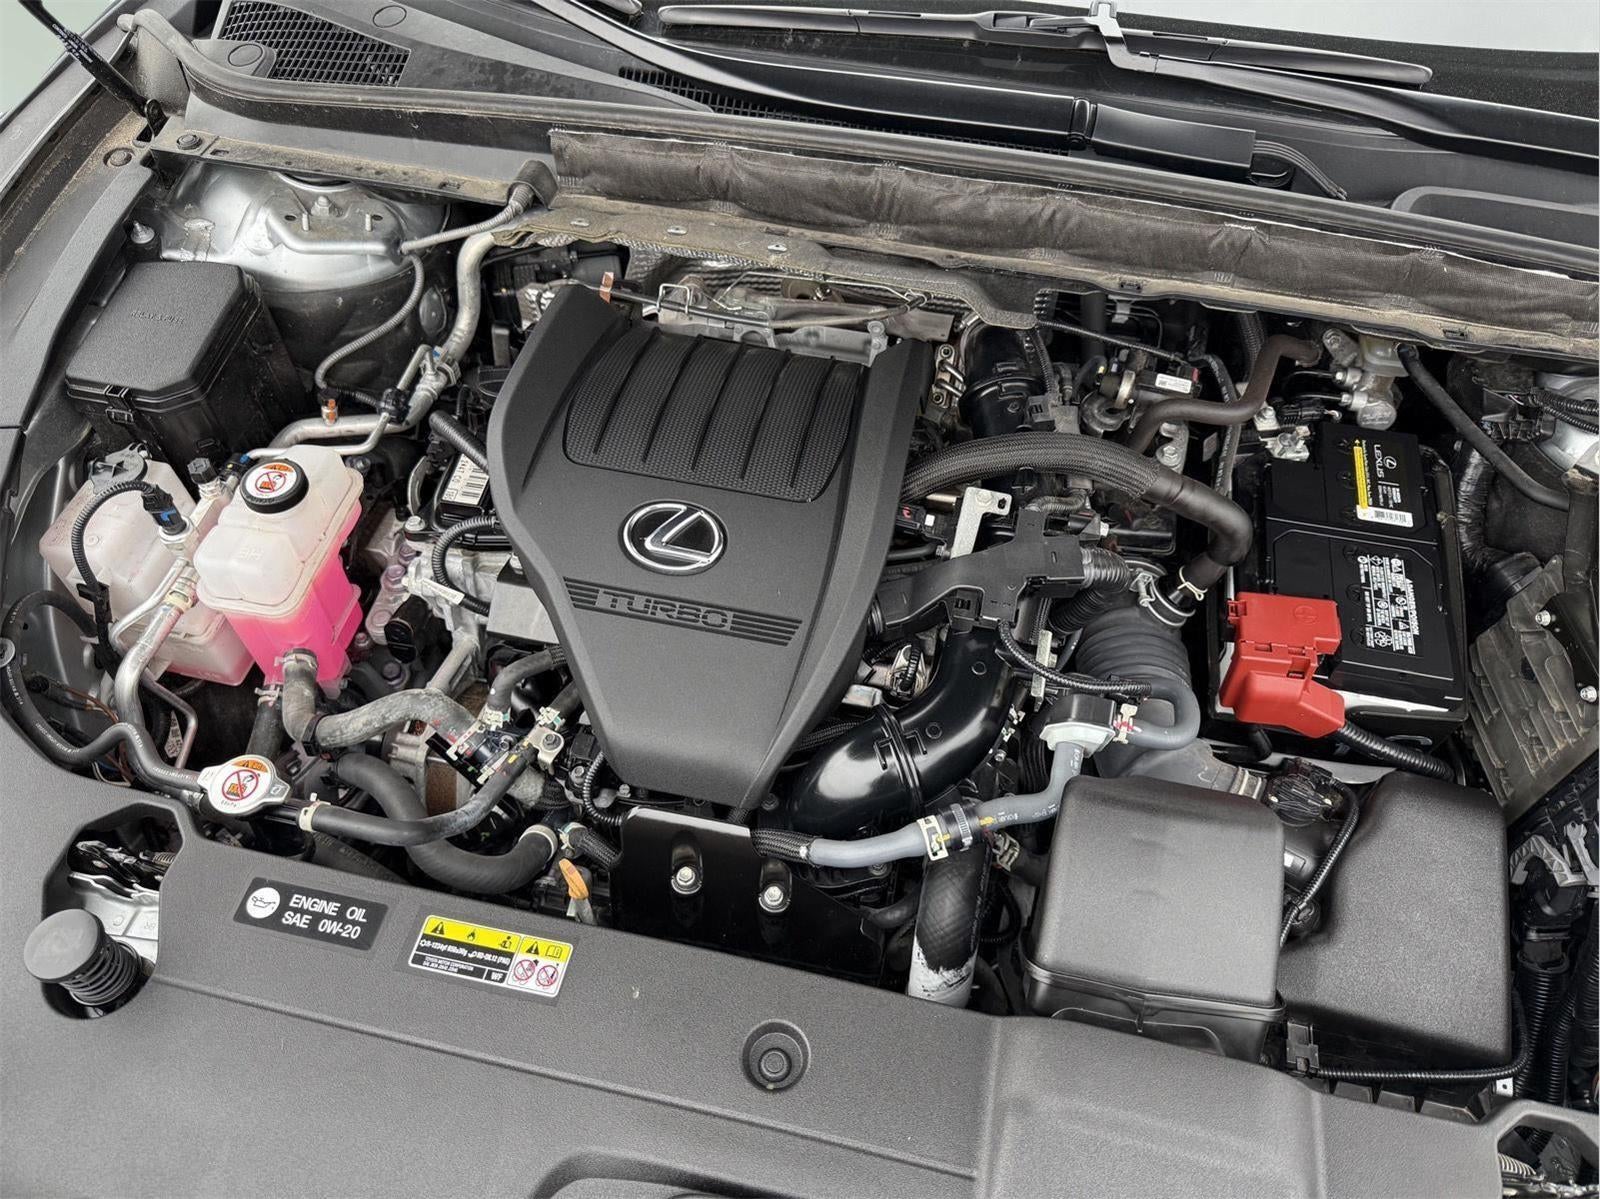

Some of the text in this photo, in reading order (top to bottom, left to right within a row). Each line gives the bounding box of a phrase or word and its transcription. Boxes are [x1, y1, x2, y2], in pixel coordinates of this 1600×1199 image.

[1373, 444, 1385, 478] LEXUS
[602, 590, 729, 629] TURBO
[289, 893, 368, 923] ENGINE OIL
[281, 910, 361, 940] SAE 0W-20
